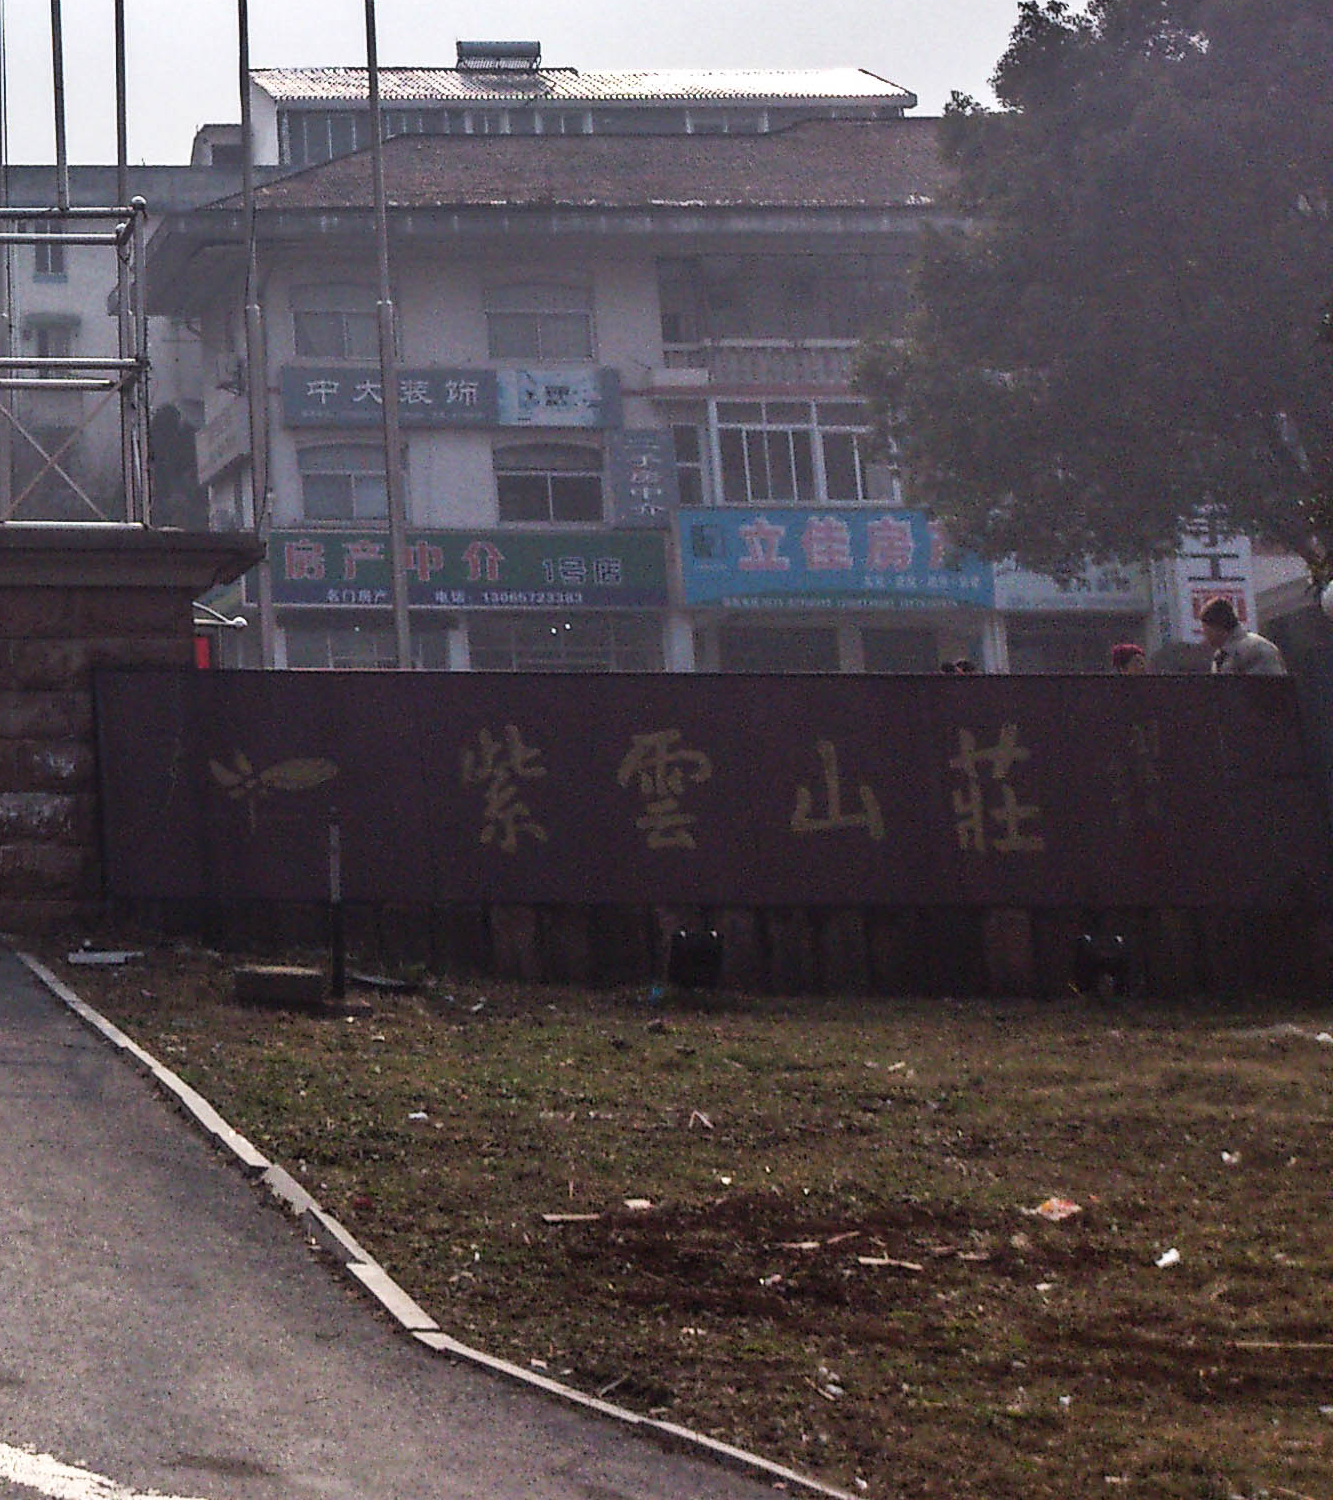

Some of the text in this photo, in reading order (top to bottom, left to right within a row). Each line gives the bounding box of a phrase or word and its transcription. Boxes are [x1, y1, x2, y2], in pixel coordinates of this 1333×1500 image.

[305, 379, 479, 405] 中大装饰
[284, 539, 623, 585] 房产中介 1号店
[462, 723, 1044, 853] 紫雲山莊
